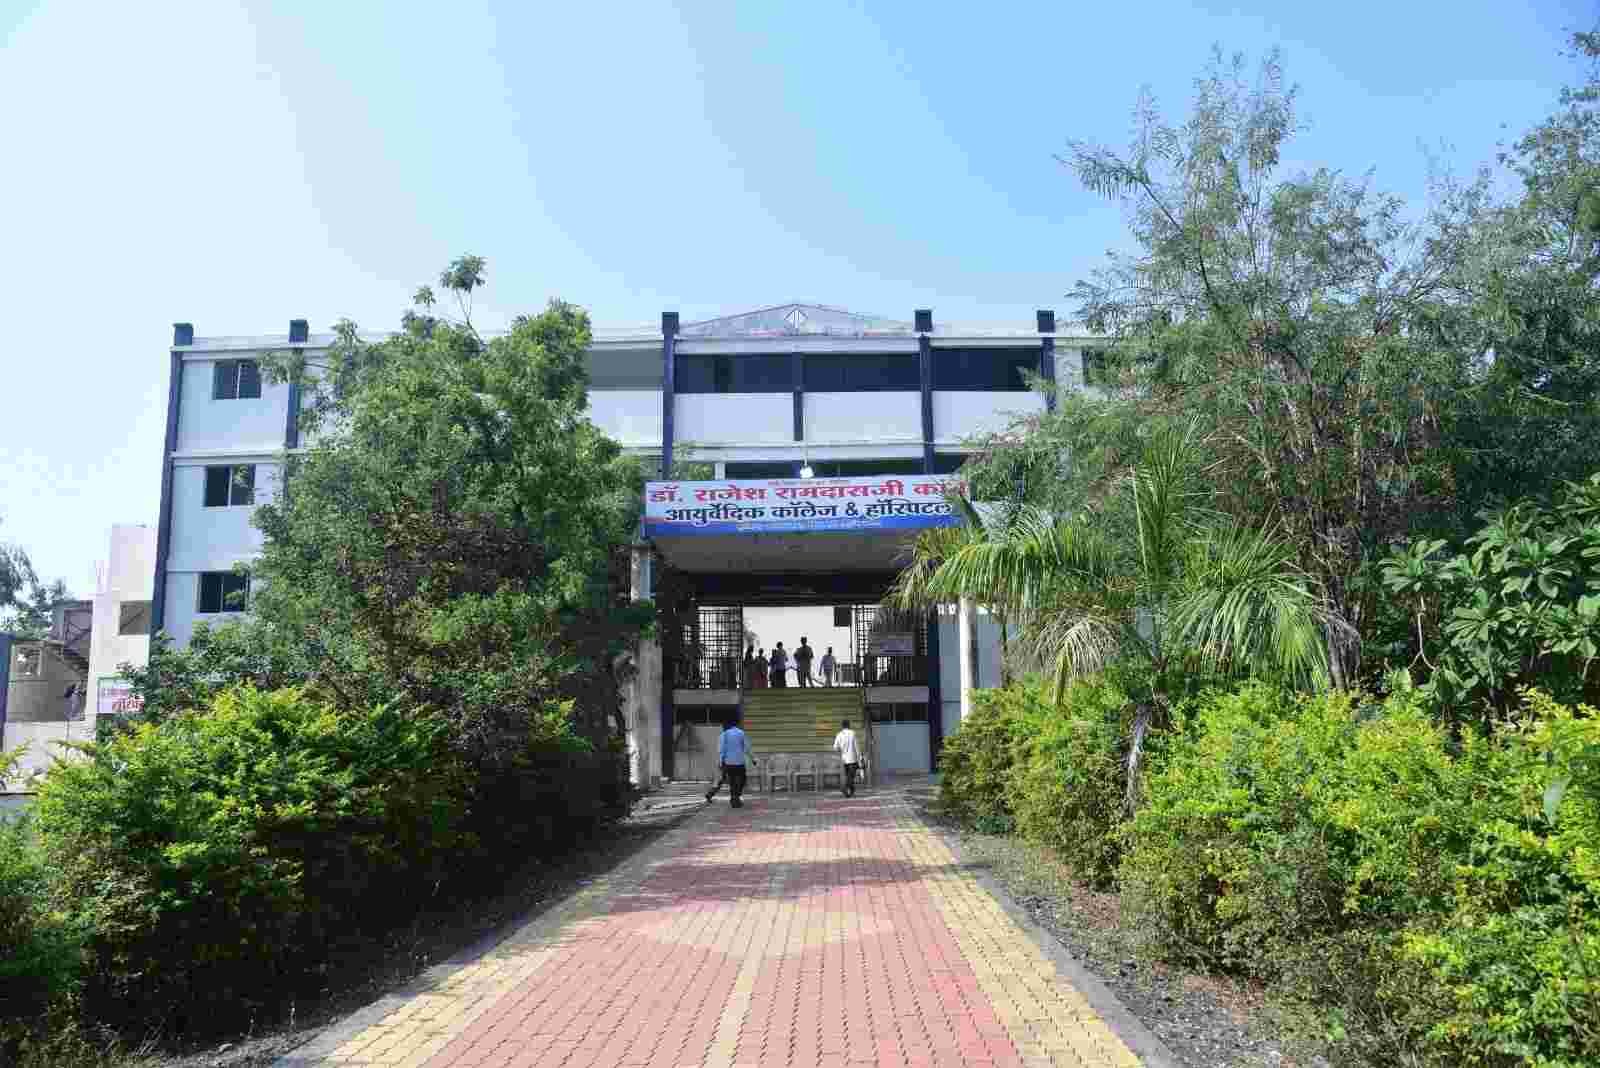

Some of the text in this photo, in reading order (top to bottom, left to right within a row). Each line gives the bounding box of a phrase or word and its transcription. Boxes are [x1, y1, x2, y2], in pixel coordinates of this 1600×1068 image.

[649, 484, 683, 503] डॉ.
[695, 484, 769, 501] राजेश
[775, 480, 904, 499] रामदासजी
[665, 502, 767, 527] आयुर्वेदिक
[770, 500, 836, 518] कॉलेज
[845, 501, 859, 517] &
